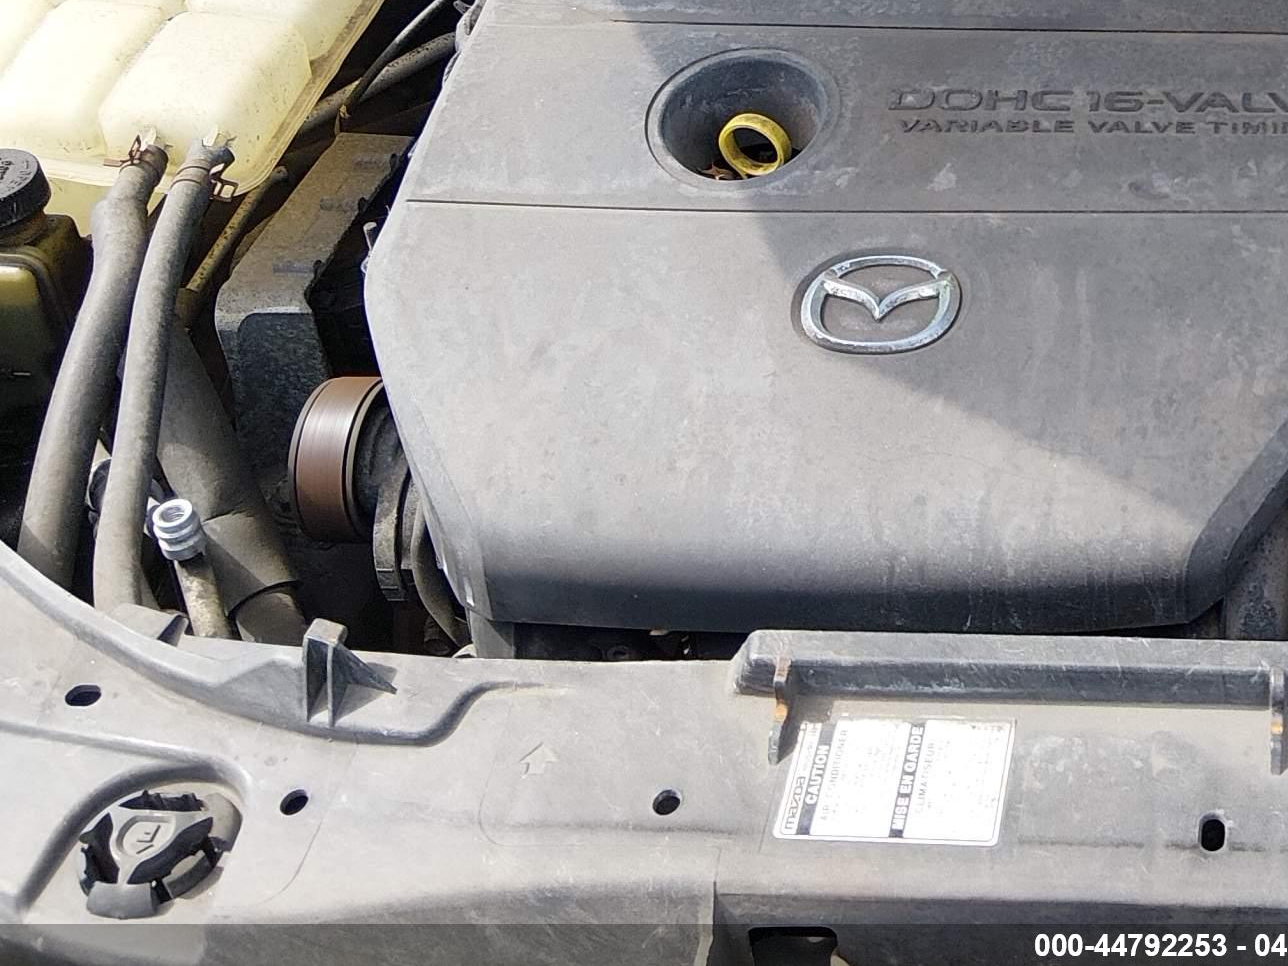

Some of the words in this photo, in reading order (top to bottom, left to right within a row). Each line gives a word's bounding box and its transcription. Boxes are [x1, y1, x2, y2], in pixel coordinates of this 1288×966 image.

[888, 89, 1075, 112] DOHC
[901, 119, 1075, 134] VARIABLE
[1088, 120, 1197, 135] VALVE
[903, 726, 924, 773] GARDE
[804, 744, 830, 805] CAUTION
[899, 774, 915, 794] EN
[891, 796, 910, 830] MISE
